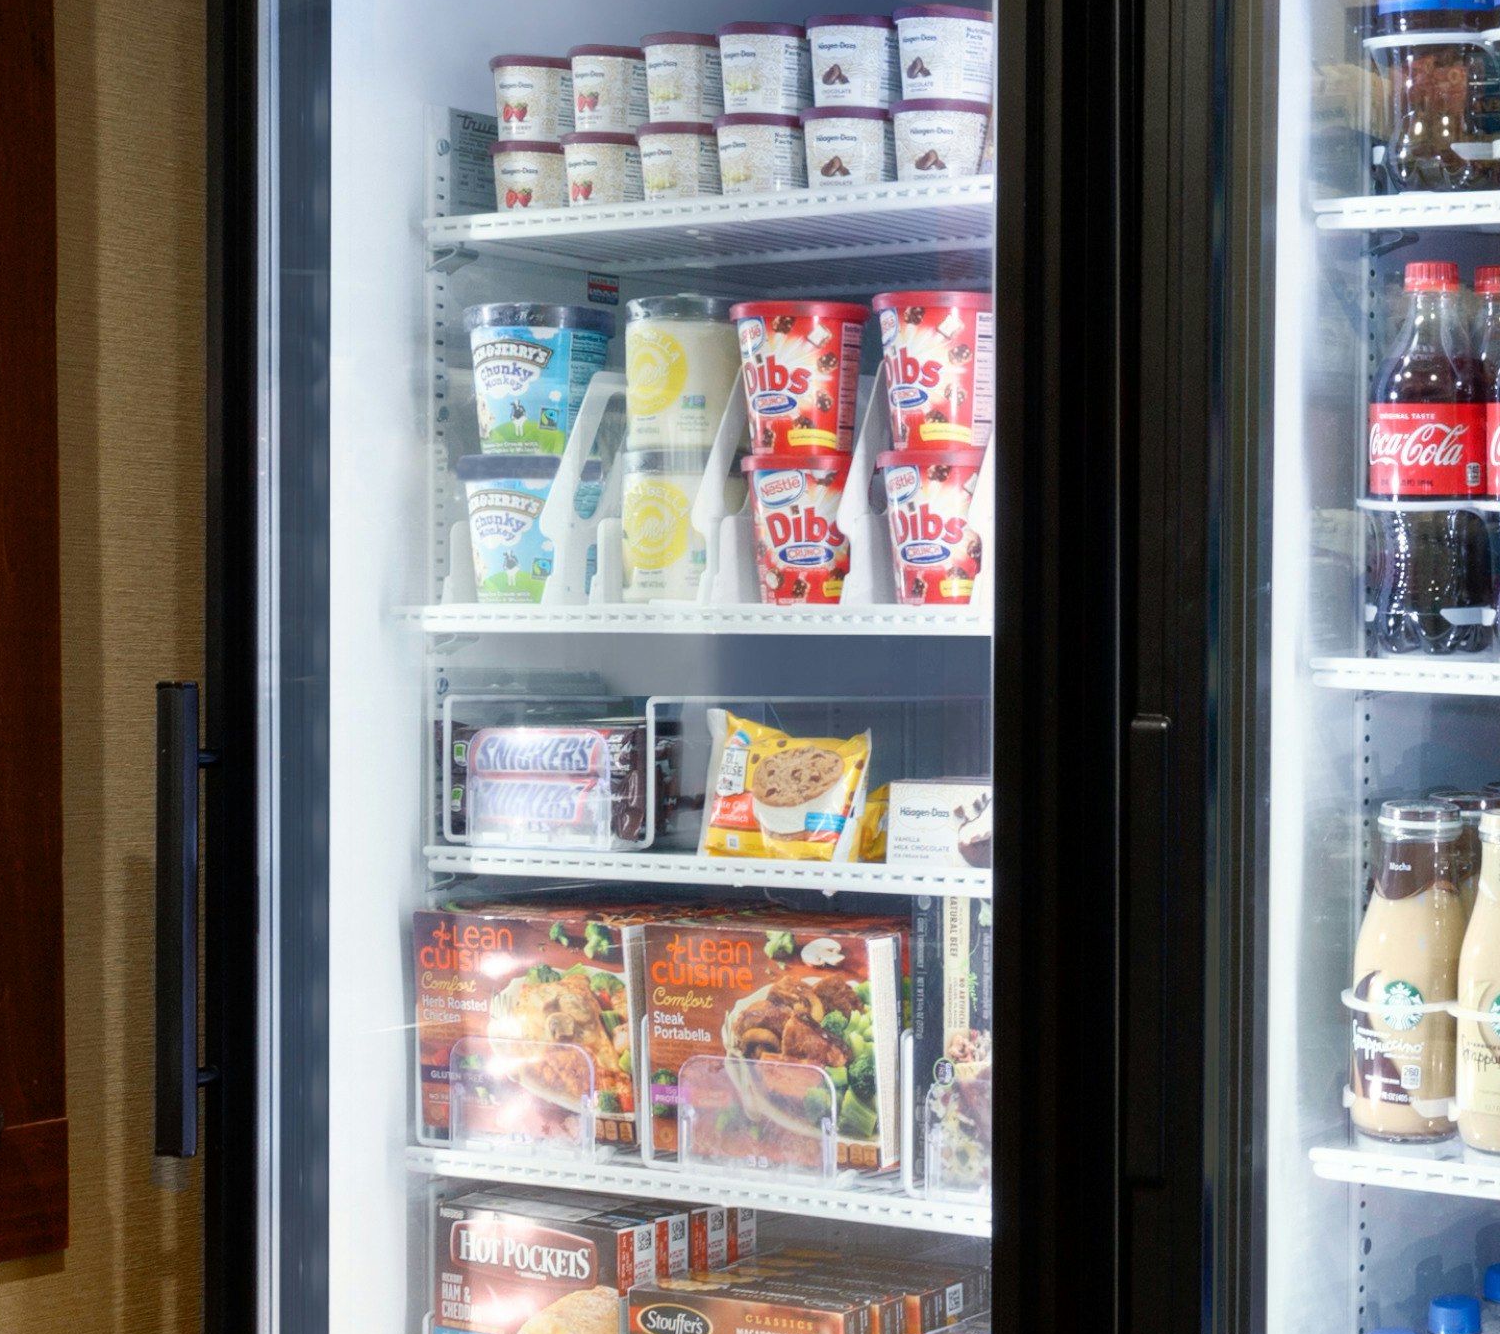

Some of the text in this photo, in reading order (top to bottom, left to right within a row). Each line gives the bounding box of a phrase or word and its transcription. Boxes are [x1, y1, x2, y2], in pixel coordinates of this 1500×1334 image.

[480, 363, 534, 381] Chunky
[743, 353, 812, 395] Dibs
[1369, 423, 1470, 466] Coca-Cola
[759, 478, 800, 498] Nestlé
[766, 504, 845, 547] Dibs
[893, 504, 968, 545] Dibs
[476, 736, 596, 771] SNICKERS
[453, 925, 513, 950] Lean
[688, 939, 752, 965] Lean
[653, 987, 713, 1012] Comfort
[653, 1011, 684, 1025] Steak
[654, 1025, 711, 1041] Portabella
[459, 1229, 502, 1264] HOT
[503, 1239, 590, 1280] POCKETS
[442, 1282, 461, 1300] HAM
[745, 1314, 814, 1331] CLASSICS
